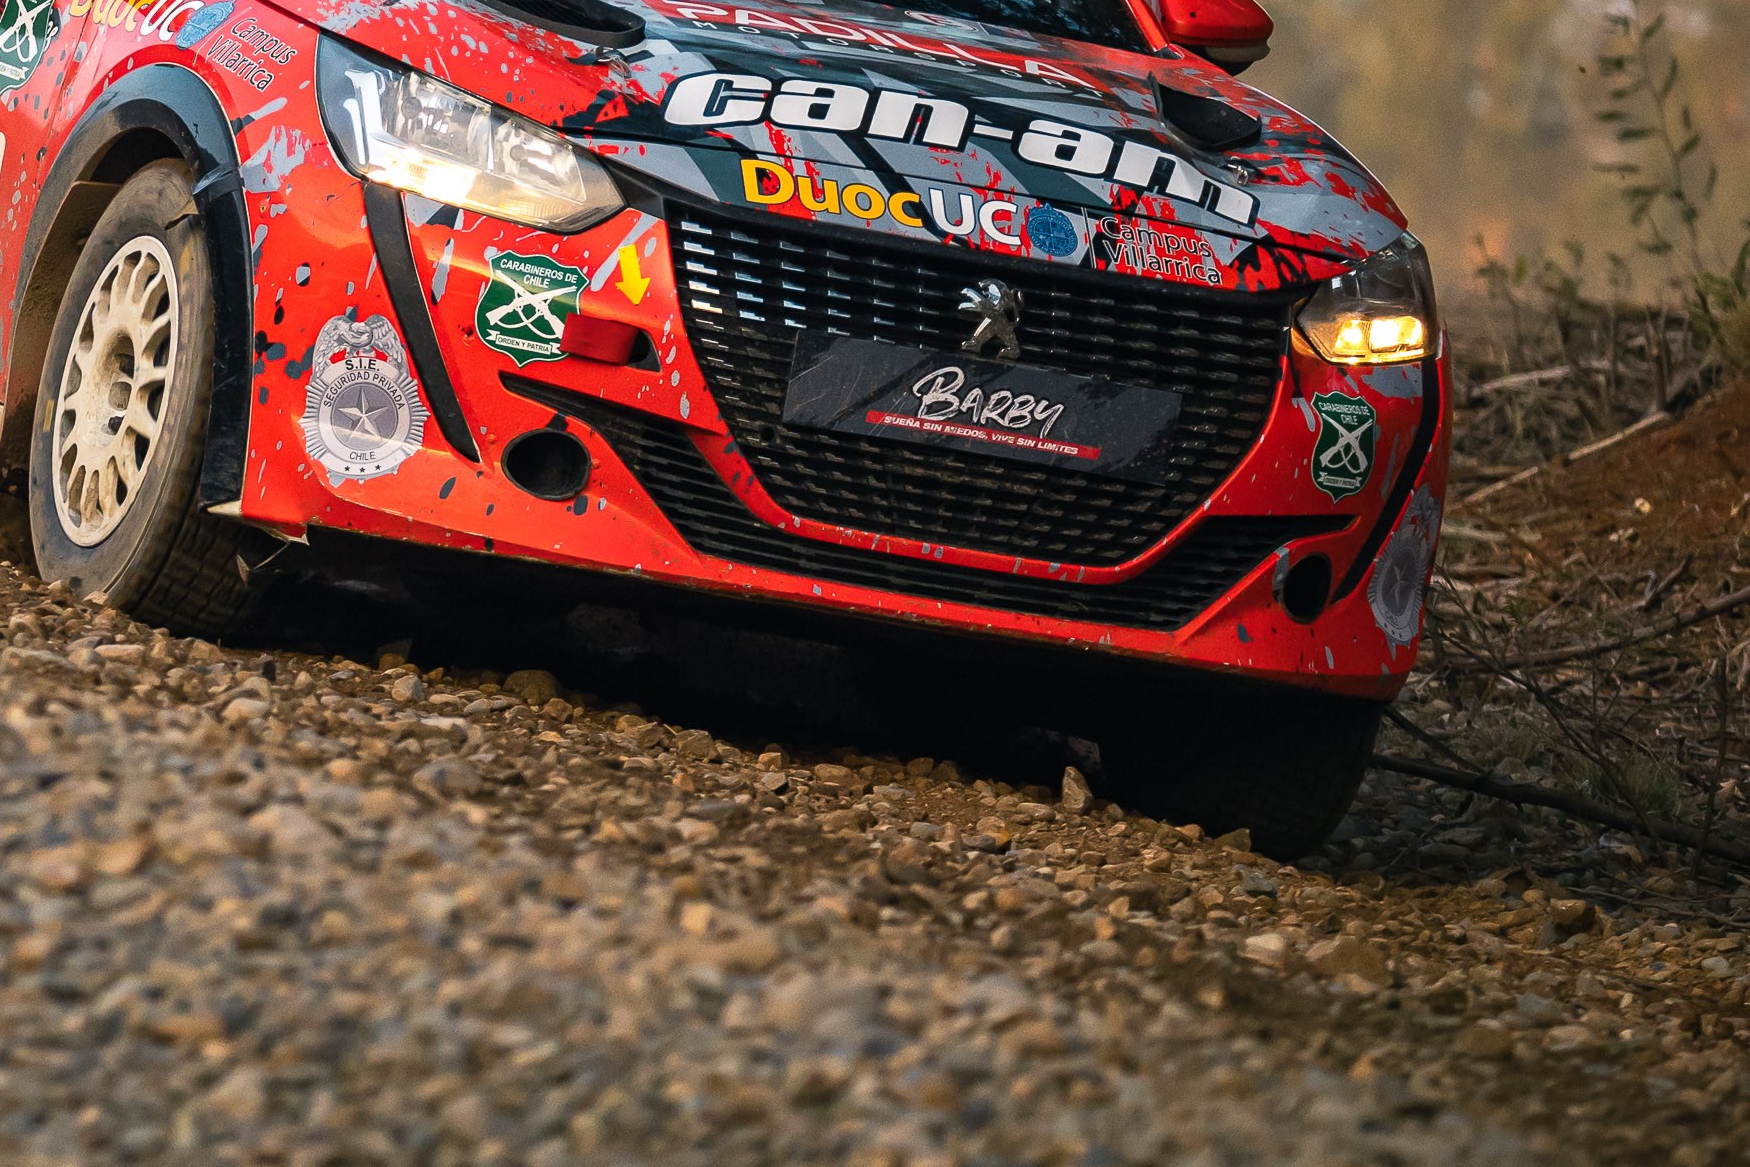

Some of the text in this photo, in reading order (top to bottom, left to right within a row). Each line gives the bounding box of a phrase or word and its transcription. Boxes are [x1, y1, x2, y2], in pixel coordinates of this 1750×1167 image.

[231, 18, 298, 64] Campus
[662, 0, 1104, 90] PADILLA
[692, 20, 1106, 98] MOTORSPORT
[206, 34, 274, 92] Villarrica
[664, 73, 1260, 226] can-am
[1101, 216, 1213, 258] Campus
[500, 258, 578, 284] CARABINEROS DE
[523, 274, 551, 289] CHILE
[1102, 239, 1223, 286] Villarrica
[345, 358, 380, 372] S.I.E.
[497, 336, 550, 353] ORDEN Y PATRIA
[323, 371, 406, 410] SEGURIDAD PRIVADA
[884, 414, 920, 429] SUEÑA
[923, 422, 943, 432] SIN
[945, 425, 988, 440] MIEDOS,
[1016, 437, 1037, 448] SIN
[1037, 441, 1079, 455] LIMITES
[349, 451, 377, 461] CHILE
